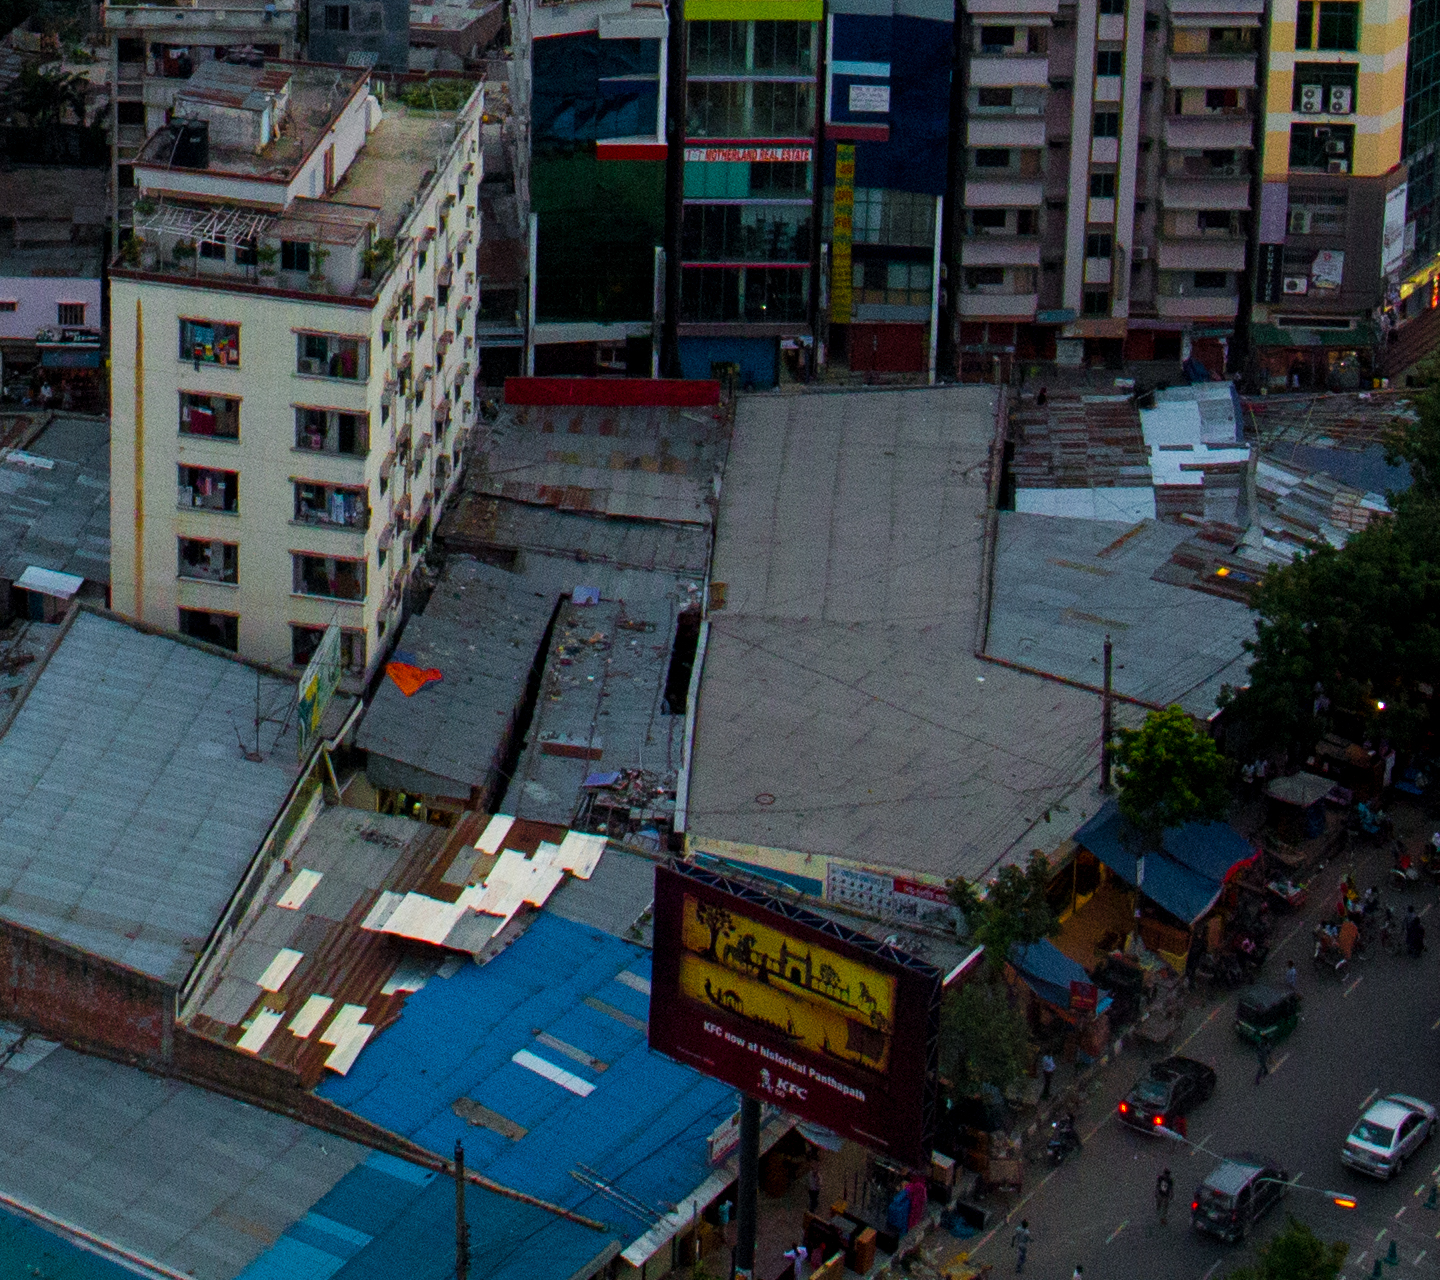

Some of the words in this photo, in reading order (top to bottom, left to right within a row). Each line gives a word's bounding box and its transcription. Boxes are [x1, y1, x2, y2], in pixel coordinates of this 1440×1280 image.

[702, 1020, 723, 1037] KFC
[724, 1031, 746, 1048] now
[747, 1042, 759, 1054] at
[759, 1045, 807, 1076] historical
[808, 1068, 866, 1102] Panthapath
[777, 1078, 808, 1101] KFC
